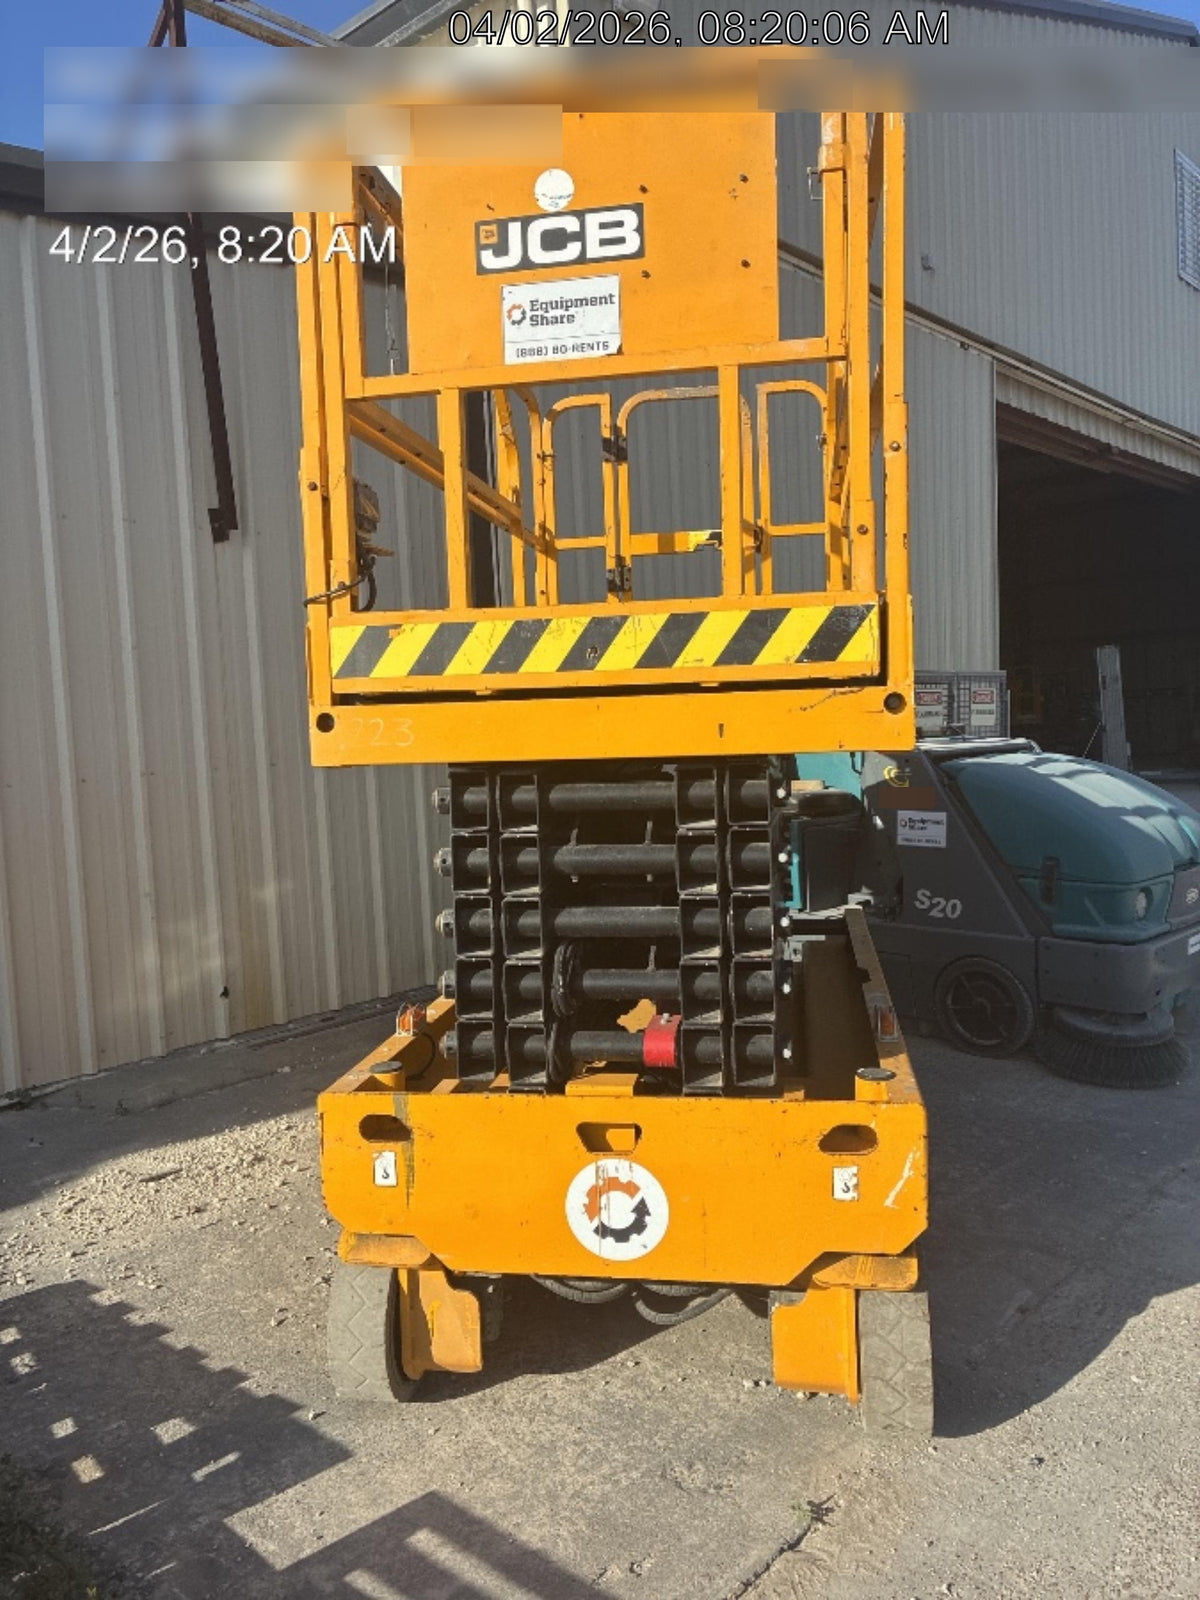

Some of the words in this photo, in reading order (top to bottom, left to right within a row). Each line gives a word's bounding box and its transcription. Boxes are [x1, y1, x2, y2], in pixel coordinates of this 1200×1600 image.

[480, 209, 641, 269] JCB
[529, 292, 616, 314] Equipment
[529, 313, 576, 327] Share
[914, 889, 962, 918] S20
